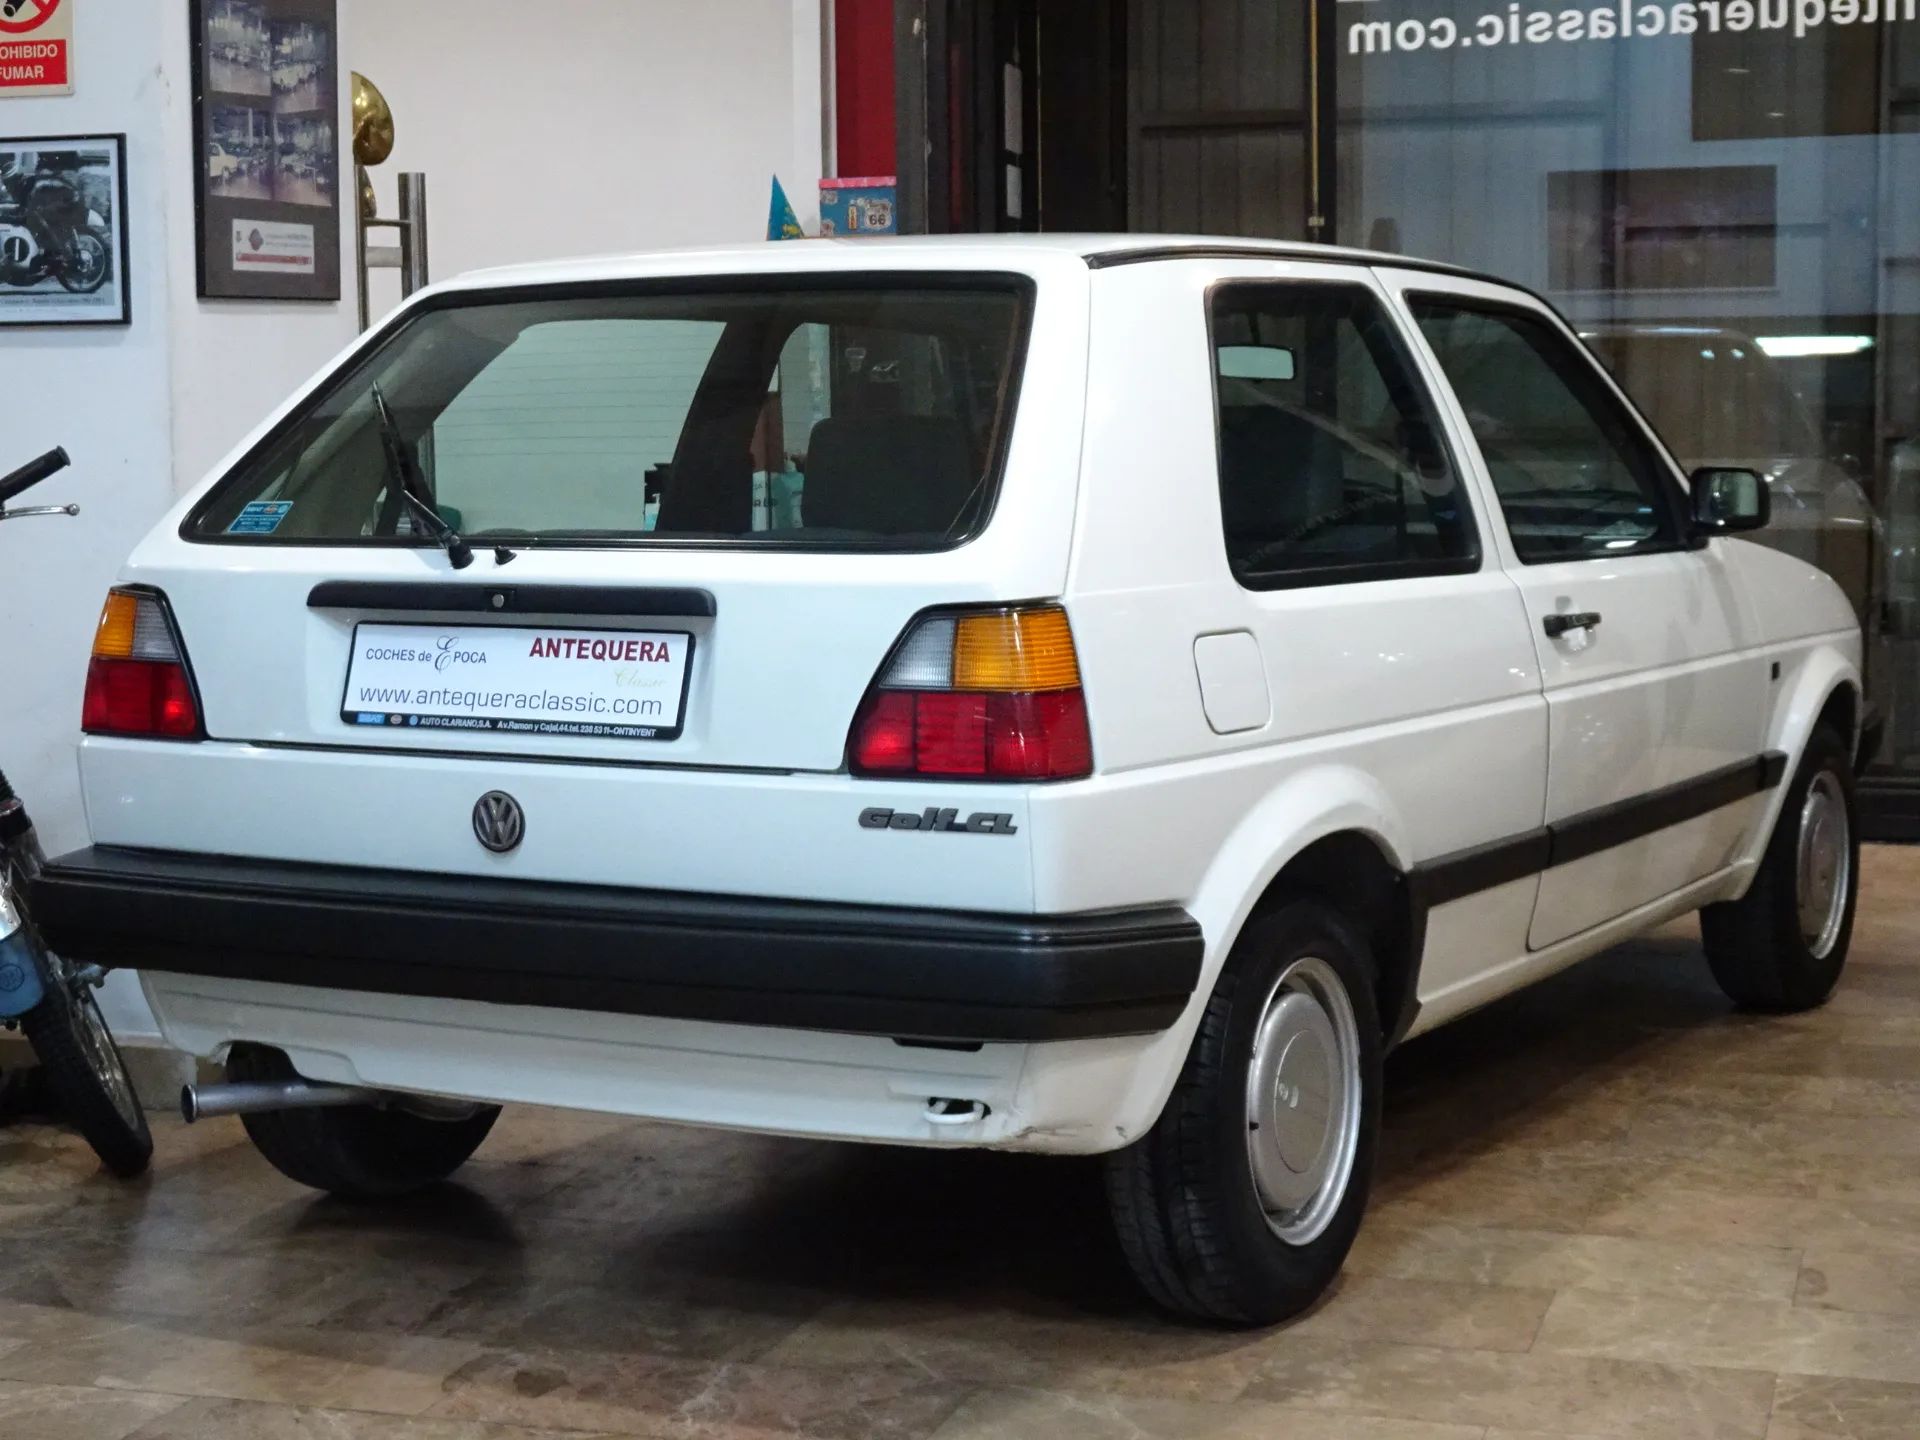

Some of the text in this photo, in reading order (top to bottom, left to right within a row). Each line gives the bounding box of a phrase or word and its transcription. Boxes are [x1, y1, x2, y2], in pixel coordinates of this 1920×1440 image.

[869, 213, 886, 226] 66
[366, 647, 415, 662] COCHES
[418, 650, 432, 662] de
[529, 637, 670, 663] ANTEQUERA
[360, 687, 662, 716] www.antequeraclassic.com
[420, 716, 440, 726] AUTO
[858, 806, 1018, 835] Golf CL
